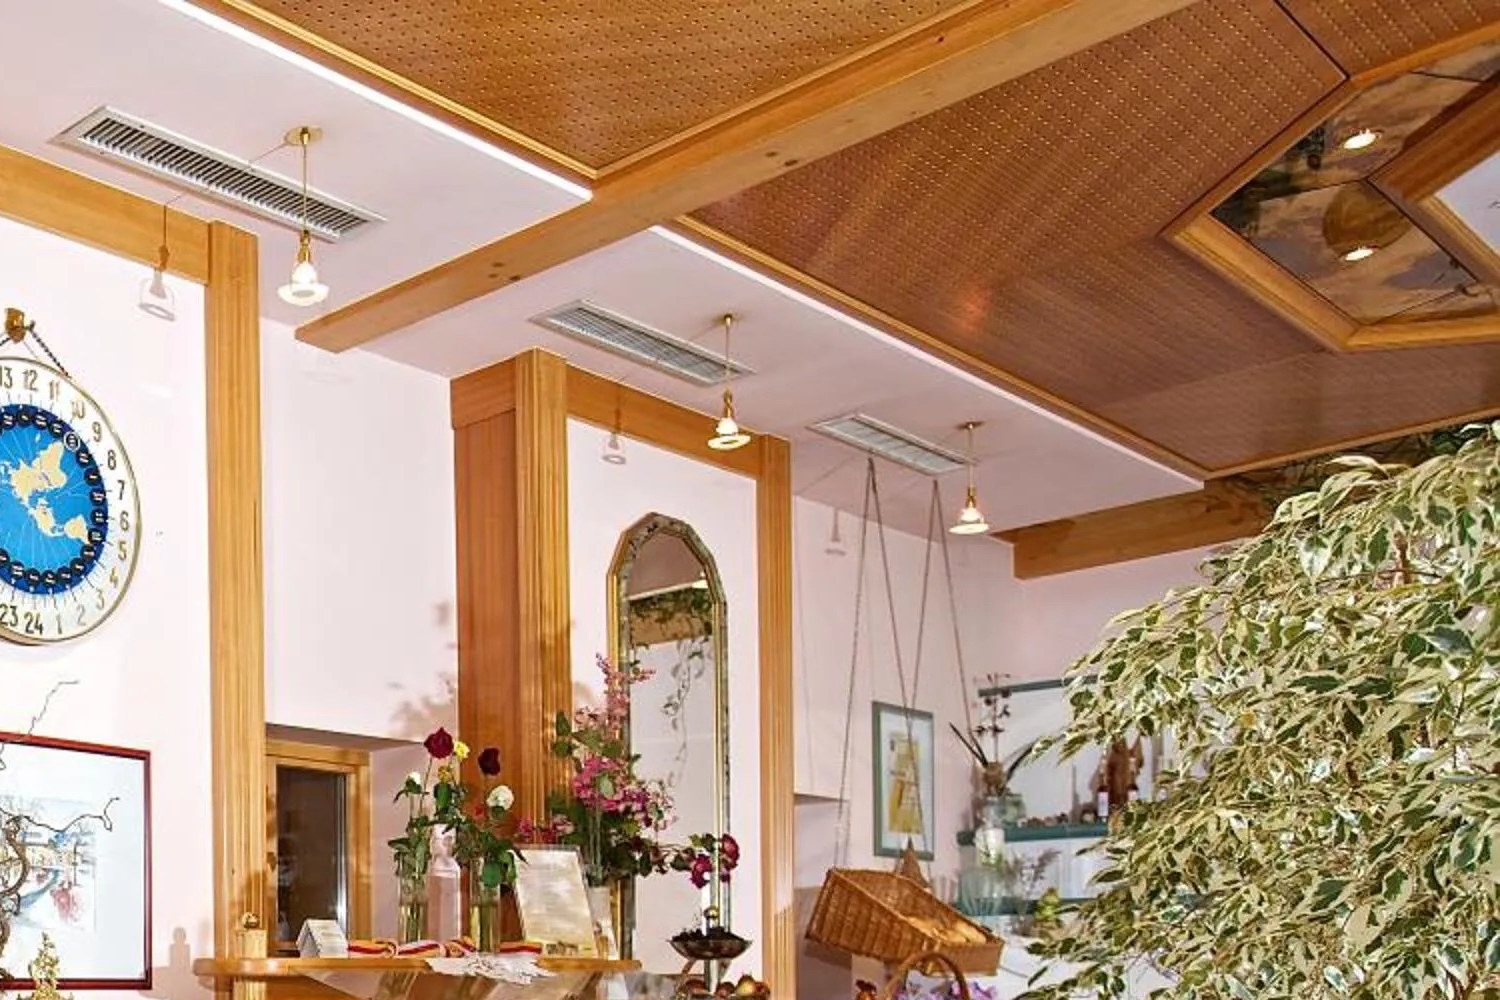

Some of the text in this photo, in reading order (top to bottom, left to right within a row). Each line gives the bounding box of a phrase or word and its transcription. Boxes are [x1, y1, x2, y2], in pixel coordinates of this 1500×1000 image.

[22, 369, 38, 391] 12
[49, 380, 59, 400] 11
[92, 421, 102, 442] 9
[107, 449, 117, 470] 8
[117, 479, 125, 500] 7
[119, 510, 129, 531] 6
[118, 540, 127, 561] 5
[109, 566, 118, 588] 4
[96, 588, 105, 610] 3
[24, 612, 43, 634] 24
[56, 613, 62, 634] 1
[76, 604, 86, 627] 2
